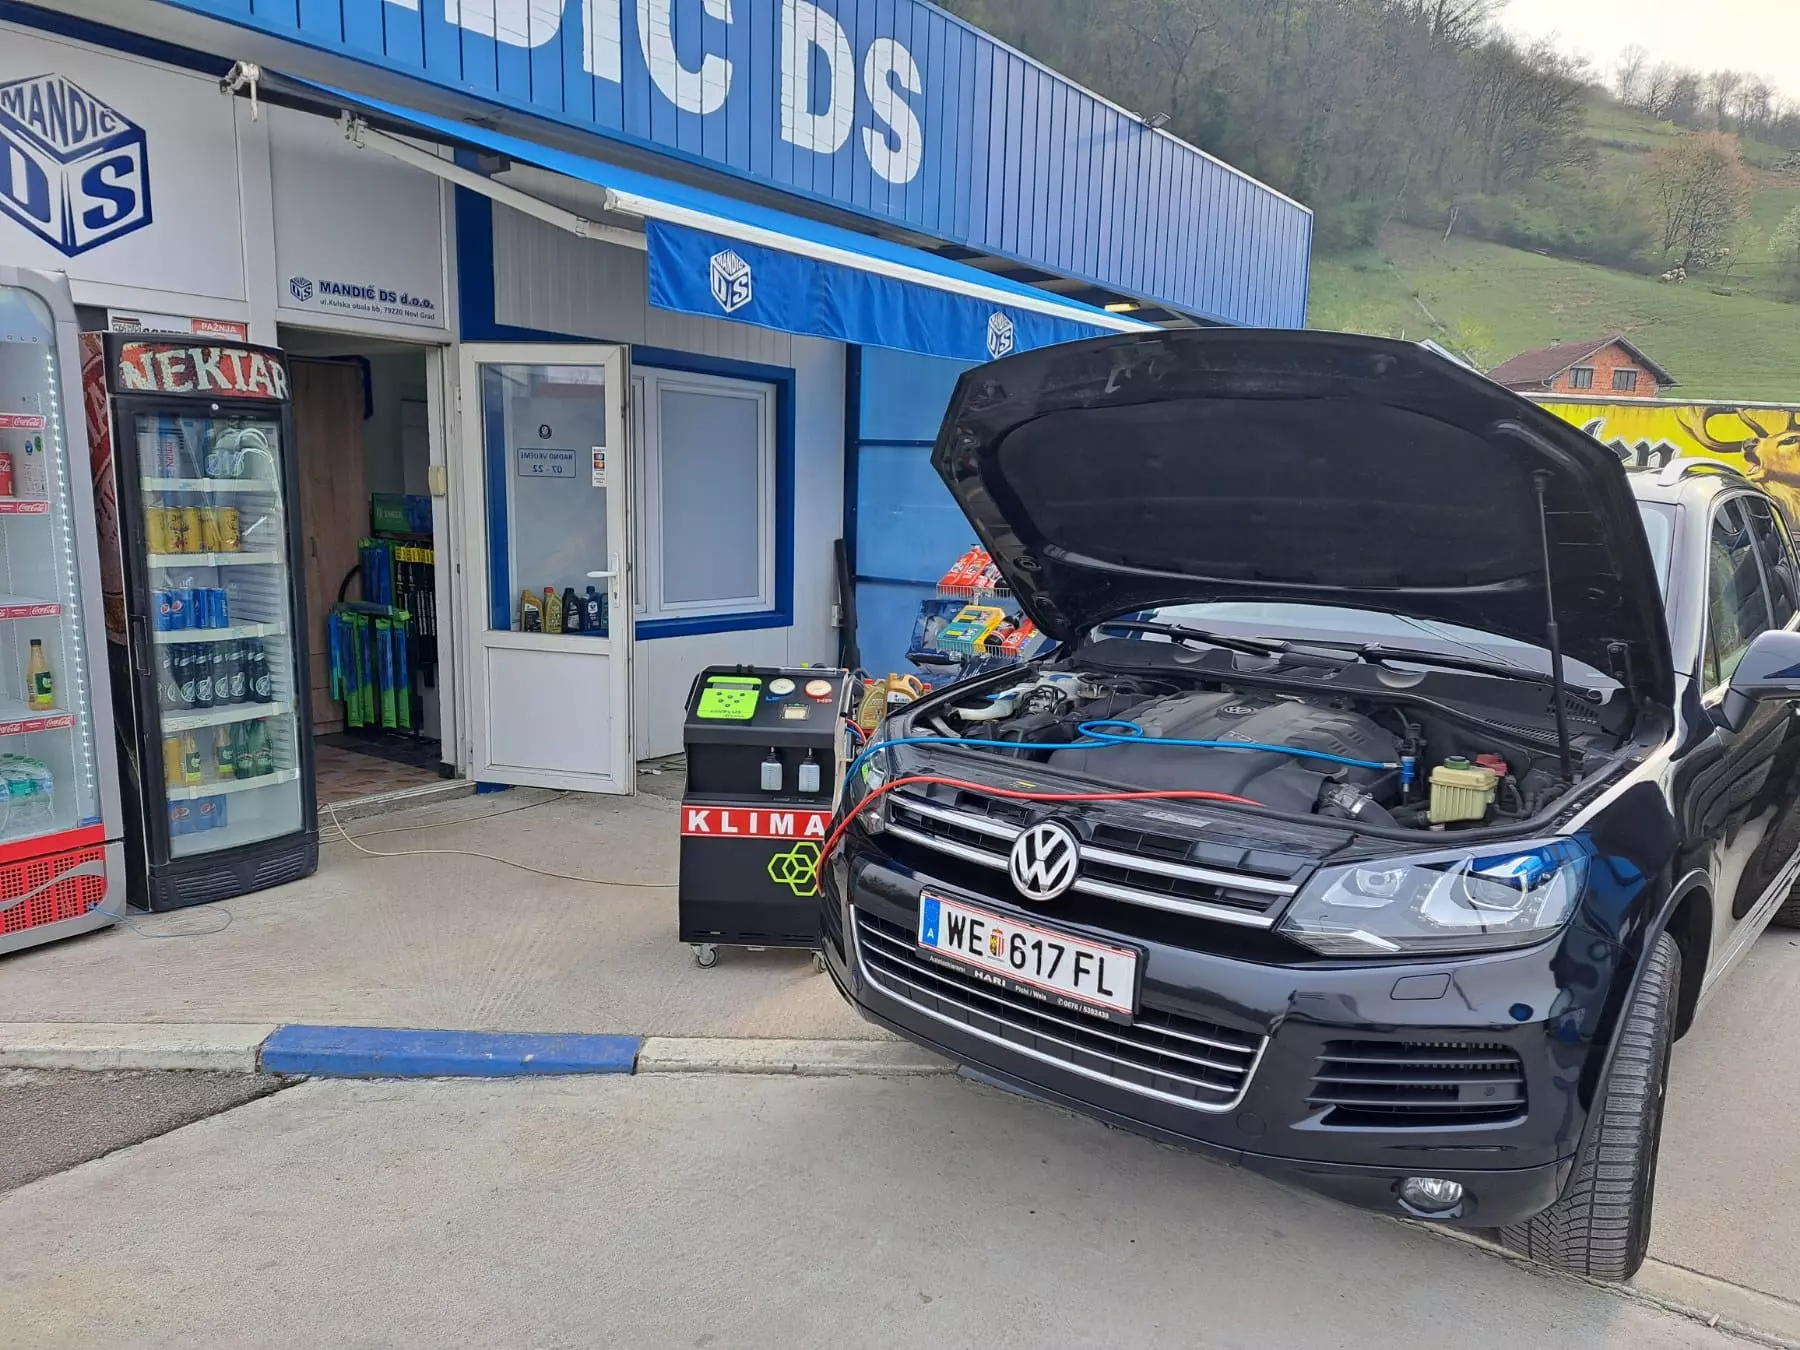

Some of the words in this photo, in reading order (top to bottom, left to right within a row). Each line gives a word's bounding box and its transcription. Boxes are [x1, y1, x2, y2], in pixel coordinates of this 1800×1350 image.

[780, 0, 923, 184] DS
[0, 138, 136, 230] DS
[379, 289, 397, 303] DS
[400, 293, 435, 309] d.o.o.
[420, 312, 435, 321] Grad
[118, 347, 290, 400] NEKTAR
[688, 809, 826, 837] KLIMA
[926, 930, 935, 939] A
[947, 911, 985, 957] WE
[1009, 932, 1066, 980] 617
[1073, 950, 1114, 998] FL
[974, 970, 1006, 988] HARI
